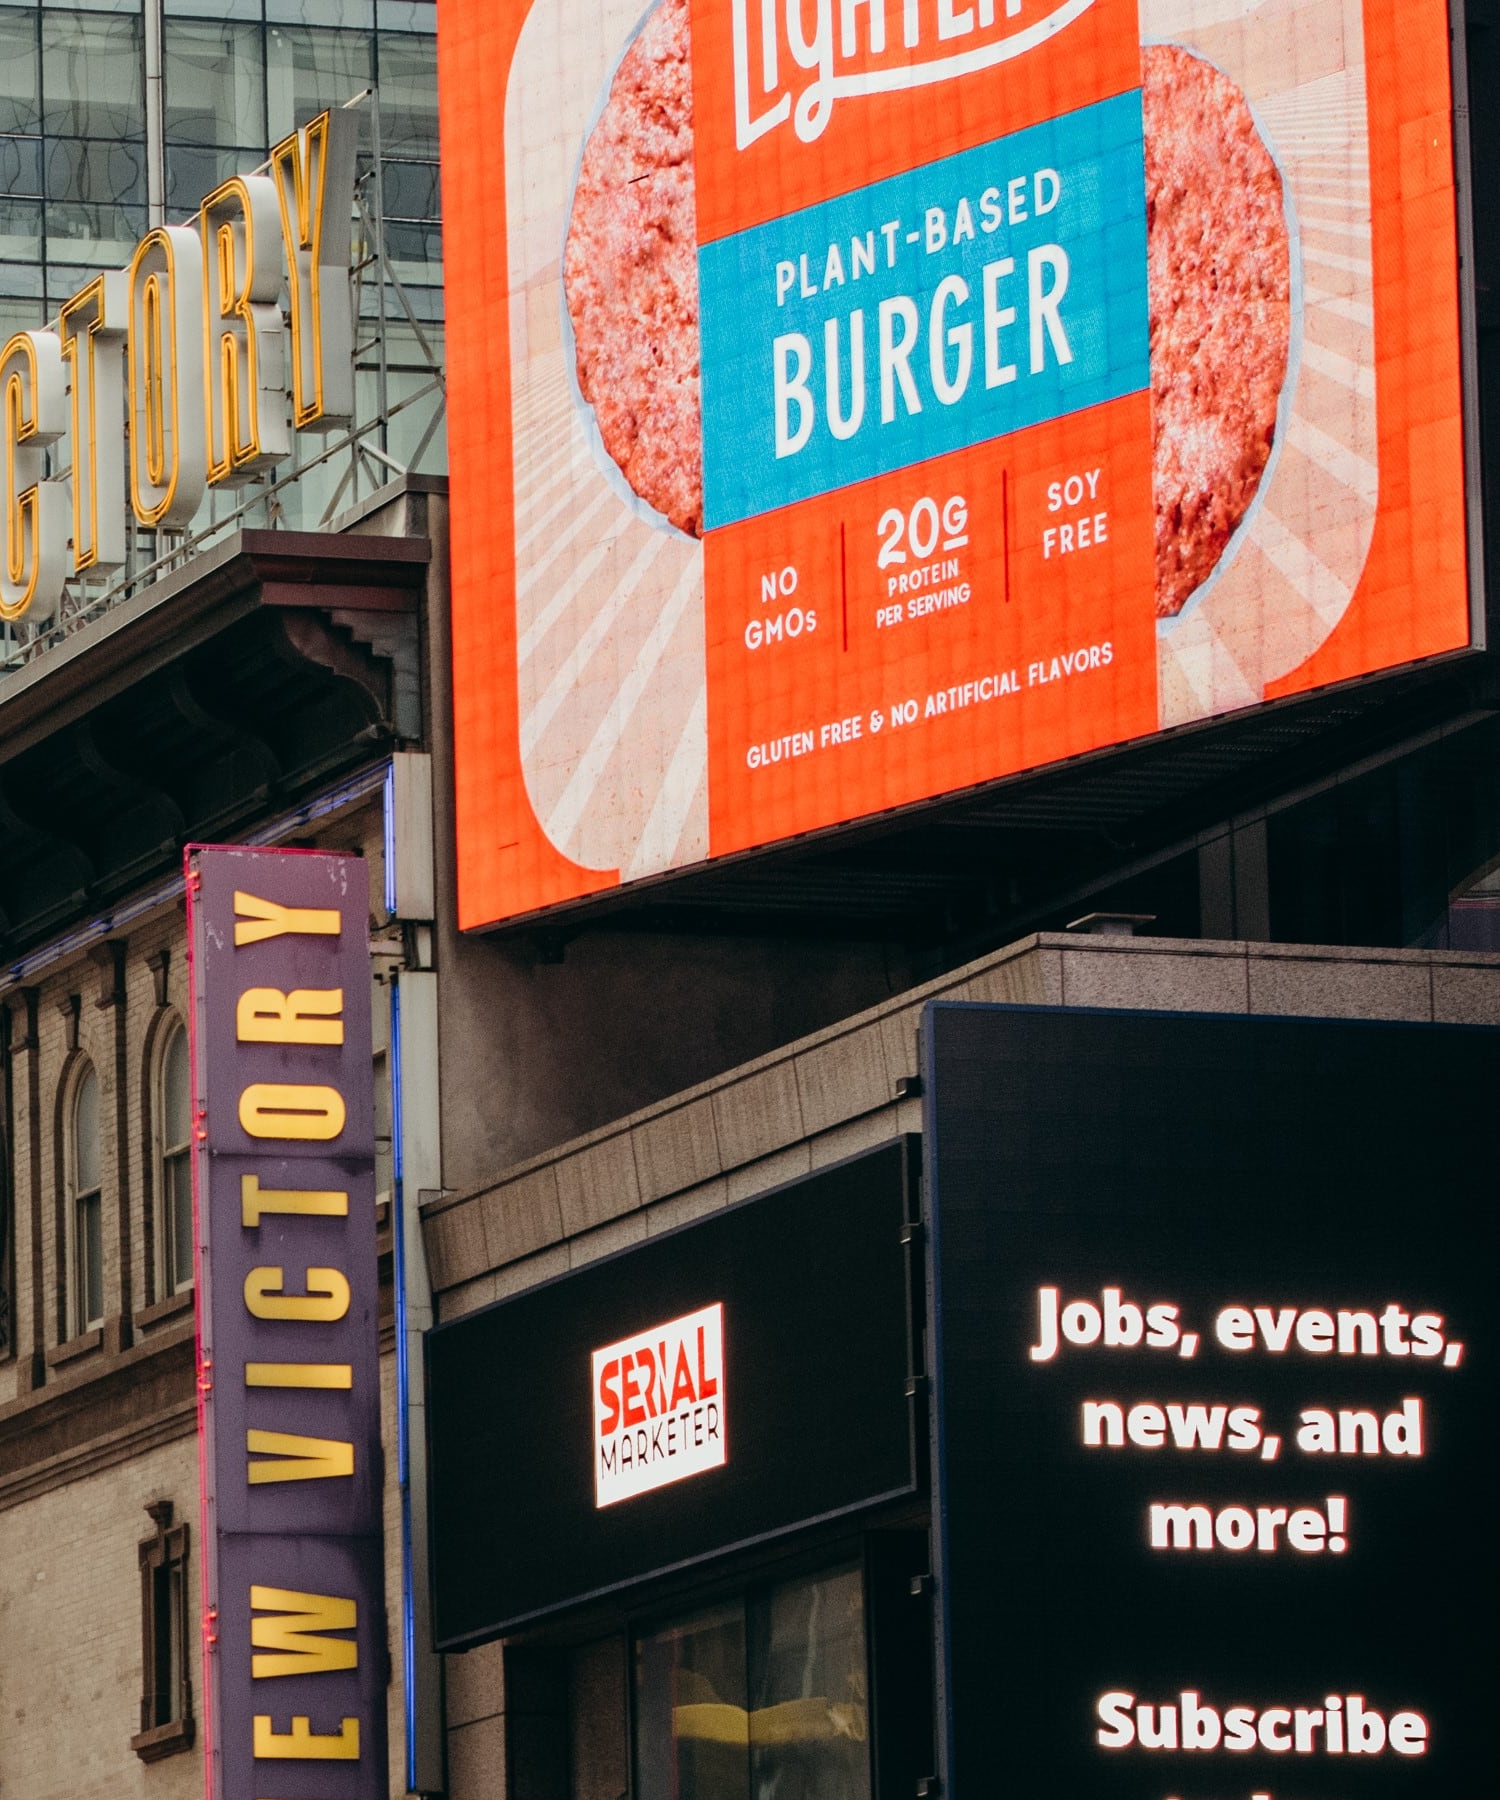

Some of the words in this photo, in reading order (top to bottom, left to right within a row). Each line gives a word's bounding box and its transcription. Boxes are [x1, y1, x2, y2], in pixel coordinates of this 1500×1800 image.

[774, 166, 1064, 308] PLANT-BASED
[772, 240, 1074, 461] BURGER
[1047, 467, 1102, 513] SOY
[1043, 513, 1108, 559] FREE
[761, 566, 798, 603] NO
[876, 604, 902, 629] PER
[907, 582, 971, 619] SERVING
[888, 558, 959, 597] PROTEIN
[747, 731, 815, 769] GLUTEN
[820, 716, 862, 748] FREE
[869, 710, 884, 734] &
[891, 700, 918, 727] NO
[924, 670, 1021, 718] ARTIFICIAL
[1028, 642, 1113, 687] FLAVORS
[233, 889, 357, 1487] VICTORY
[1031, 1286, 1199, 1362] Jobs,
[1214, 1300, 1465, 1368] events,
[600, 1326, 718, 1437] SERIAL
[601, 1403, 720, 1480] MARKETER
[1081, 1401, 1282, 1460] news,
[1296, 1397, 1424, 1458] and
[1149, 1497, 1349, 1552] more!
[1095, 1690, 1428, 1756] Subscribe
